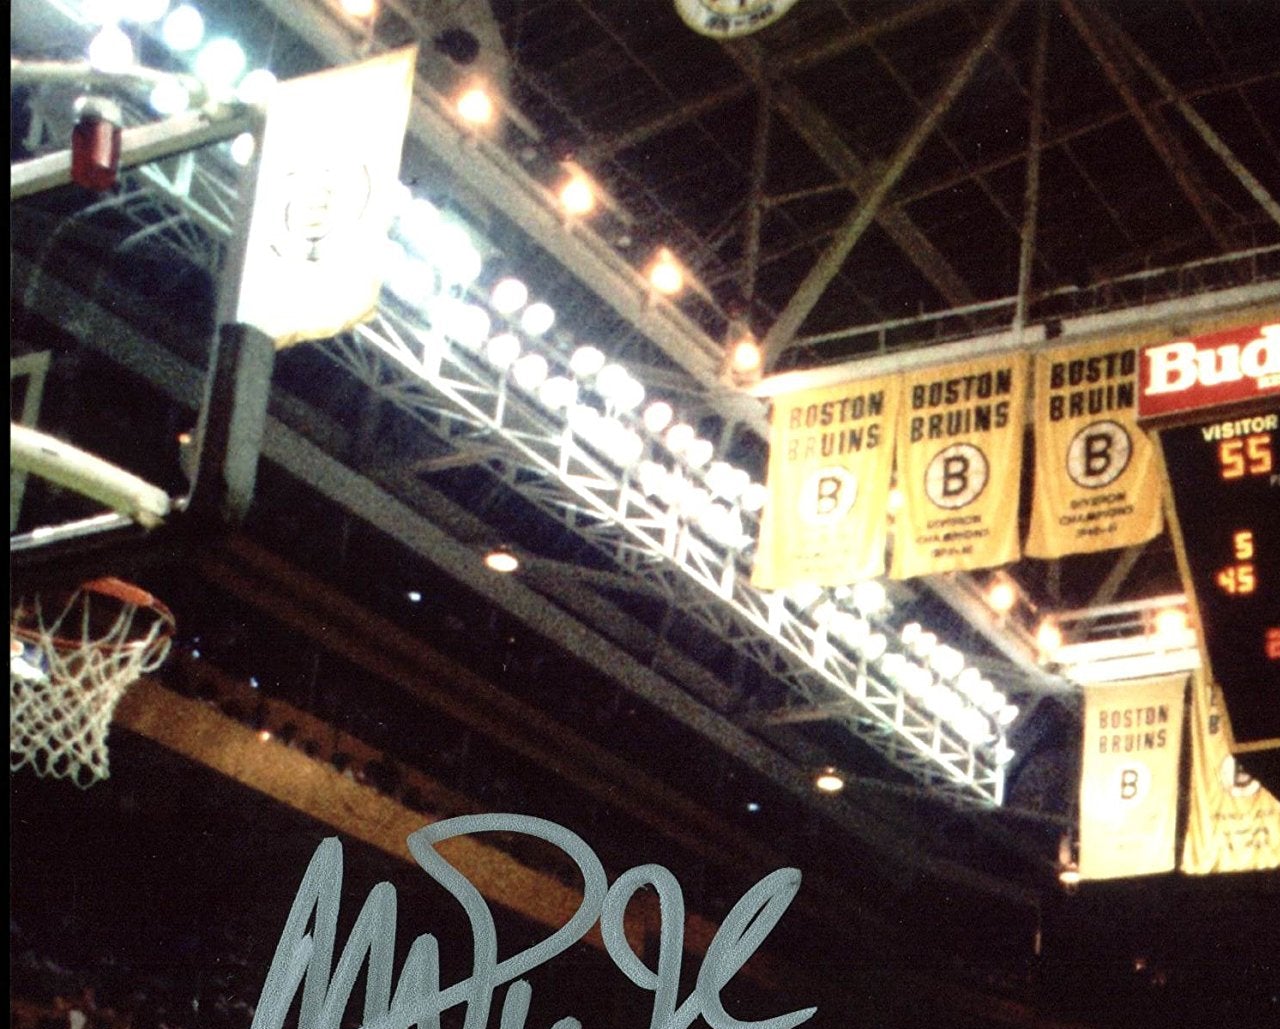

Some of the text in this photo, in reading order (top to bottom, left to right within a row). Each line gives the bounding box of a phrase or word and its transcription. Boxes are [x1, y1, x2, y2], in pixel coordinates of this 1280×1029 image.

[912, 368, 1013, 411] BOSTON
[789, 390, 885, 430] BOSTON
[910, 401, 1009, 444] BRUINS
[1202, 414, 1279, 442] VISITOR
[787, 424, 880, 461] BRUINS
[1084, 433, 1113, 477] B
[1218, 434, 1273, 479] 55
[817, 476, 842, 516] B
[942, 455, 970, 498] B
[1233, 531, 1254, 560] 5
[1099, 704, 1169, 729] BOSTON
[1099, 729, 1166, 754] BRUINS
[1121, 769, 1139, 800] B
